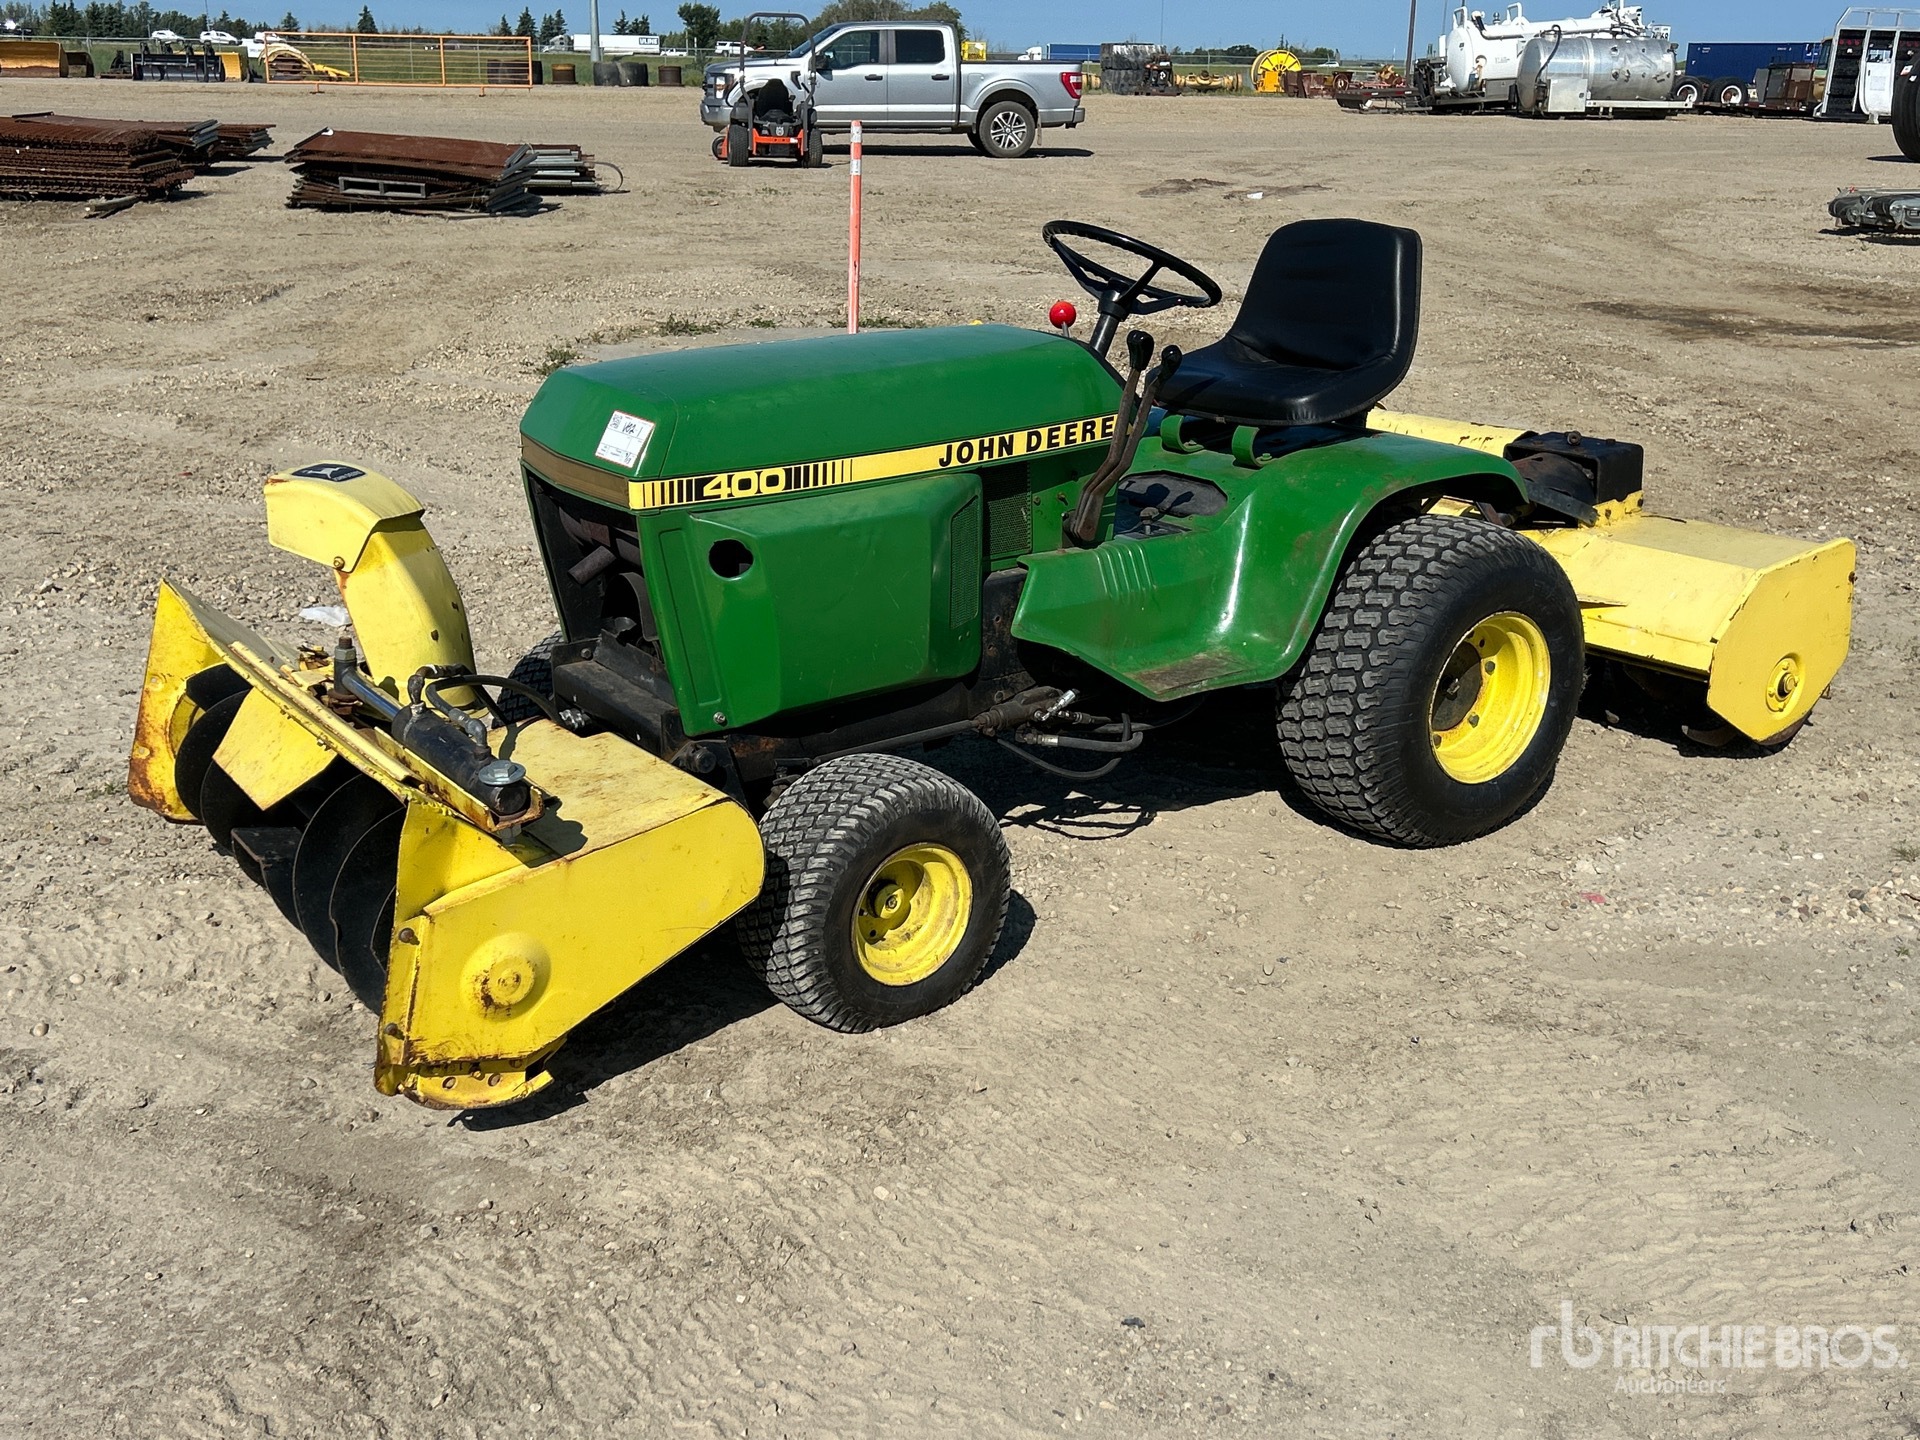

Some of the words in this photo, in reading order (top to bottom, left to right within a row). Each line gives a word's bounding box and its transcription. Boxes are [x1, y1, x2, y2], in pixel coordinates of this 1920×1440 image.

[939, 434, 1014, 467] JOHN
[1026, 416, 1115, 452] DEERE
[703, 467, 786, 500] 400
